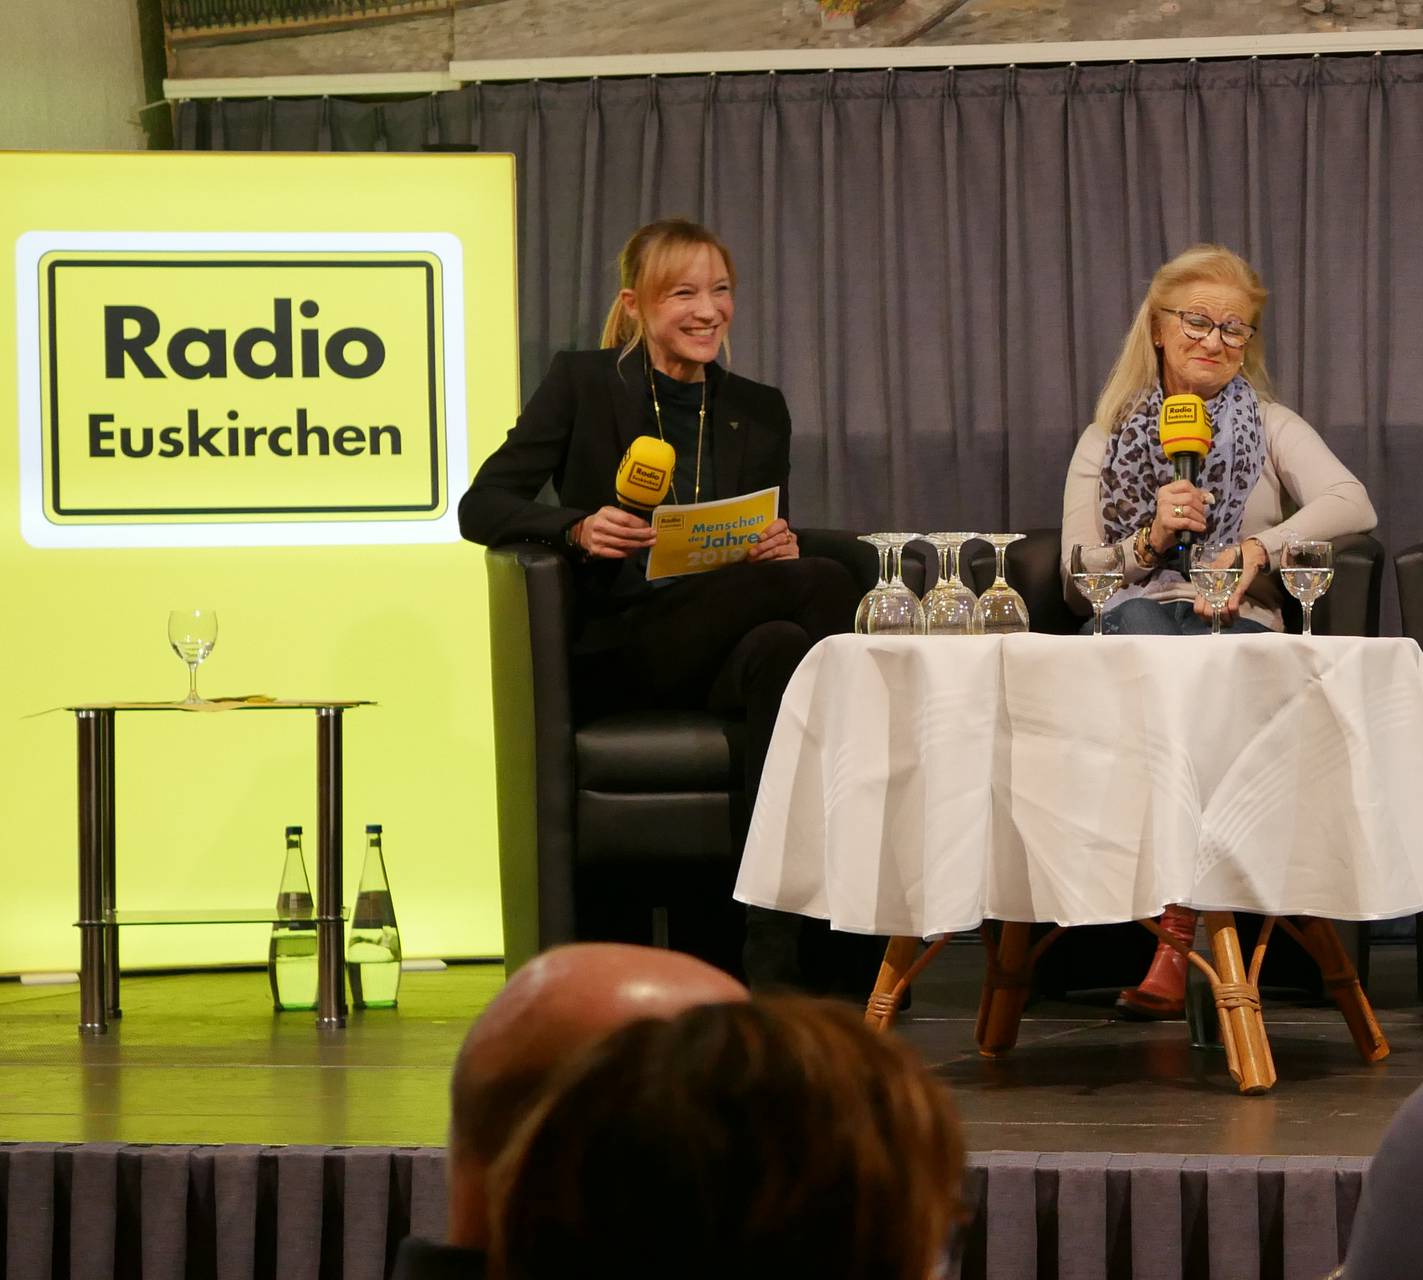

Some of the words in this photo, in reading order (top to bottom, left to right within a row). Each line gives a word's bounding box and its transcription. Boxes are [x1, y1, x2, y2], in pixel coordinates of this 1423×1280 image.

[103, 297, 386, 380] Radio
[1169, 405, 1192, 414] Radio
[88, 408, 402, 458] Euskirchen
[635, 467, 660, 481] Radio
[691, 514, 765, 534] Menschen
[701, 531, 761, 549] Jahre
